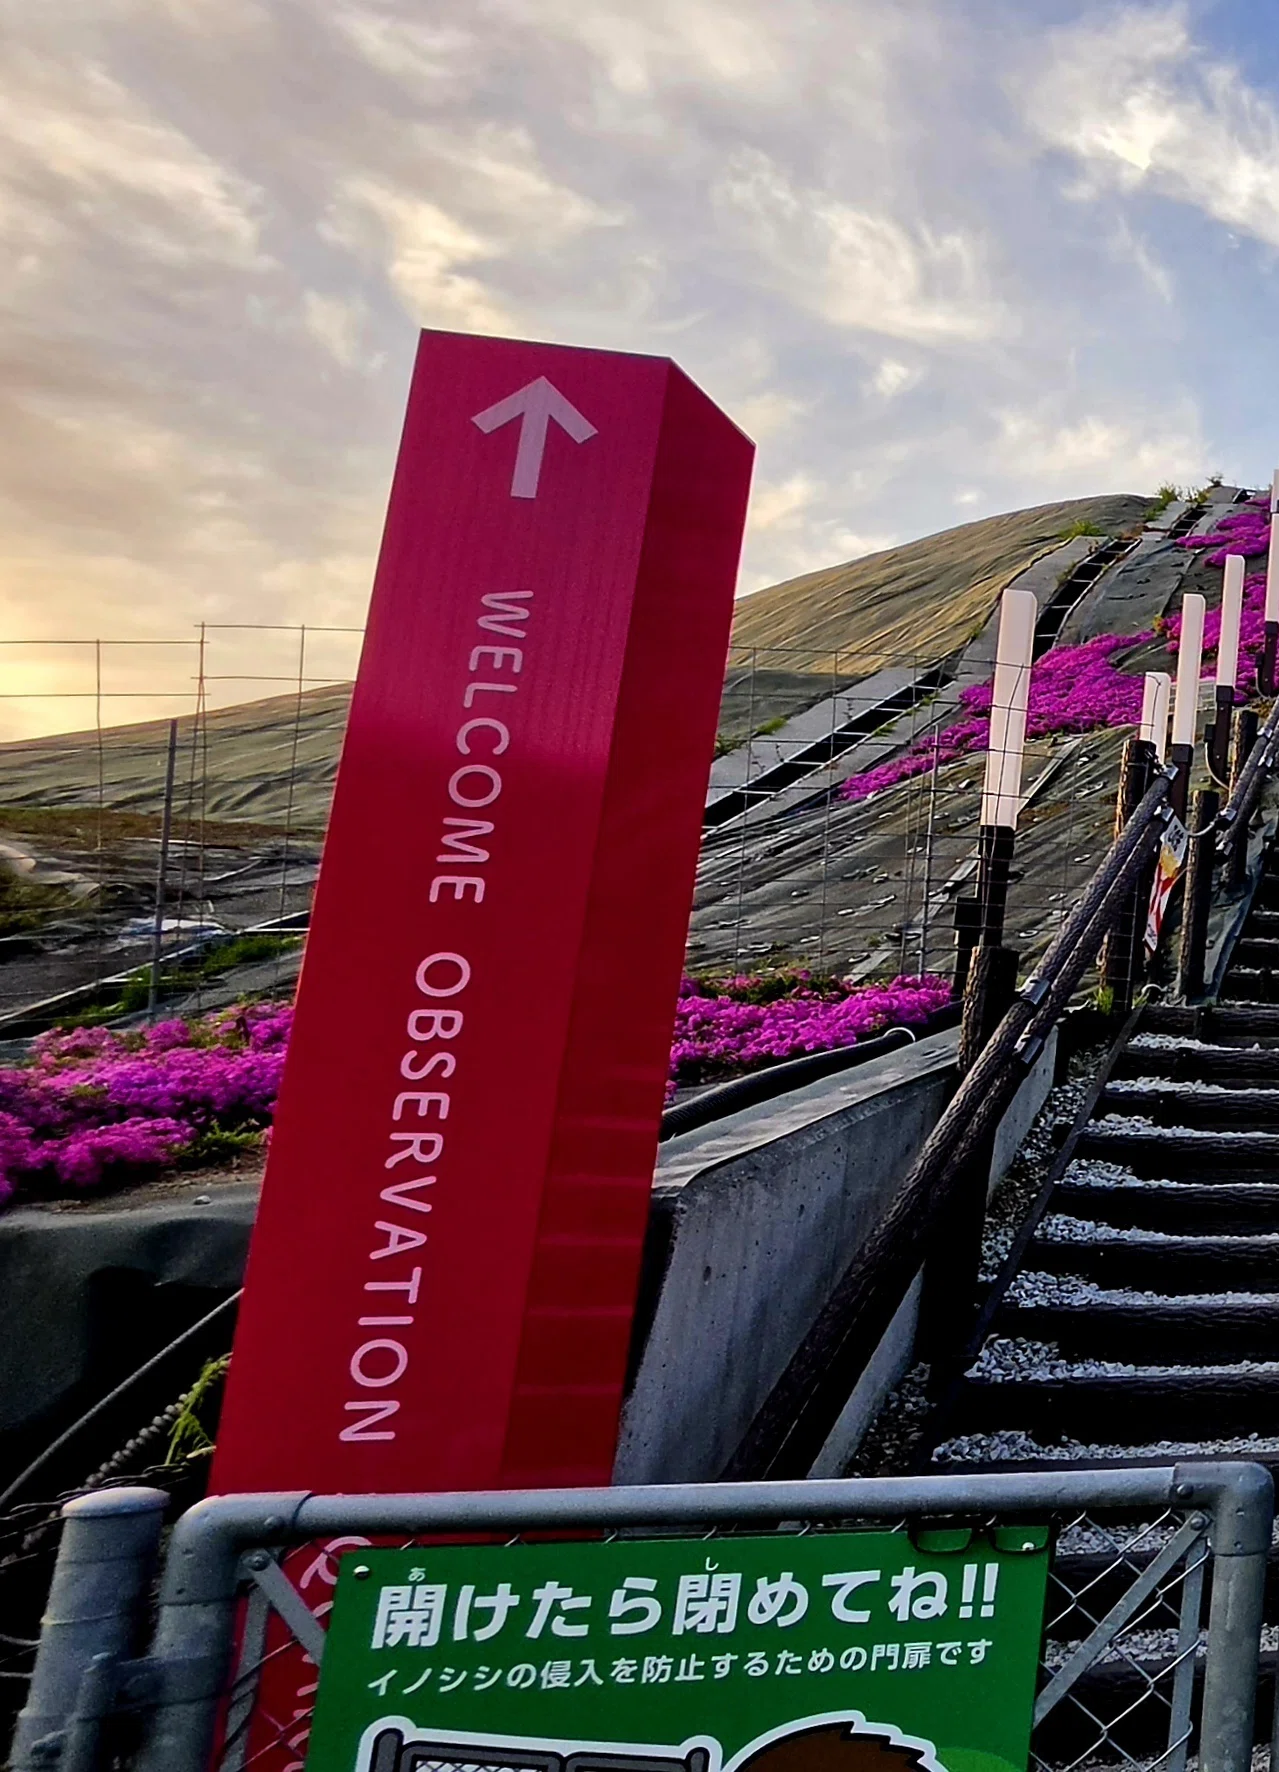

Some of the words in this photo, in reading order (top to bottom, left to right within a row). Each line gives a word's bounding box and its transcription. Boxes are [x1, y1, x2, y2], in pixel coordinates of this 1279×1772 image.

[428, 589, 534, 904] WELCOME
[338, 951, 472, 1442] OBSERVATION
[408, 1567, 426, 1582] あ
[704, 1557, 719, 1571] し
[367, 1638, 993, 1697] イノシシの侵入を防止するための門扉です
